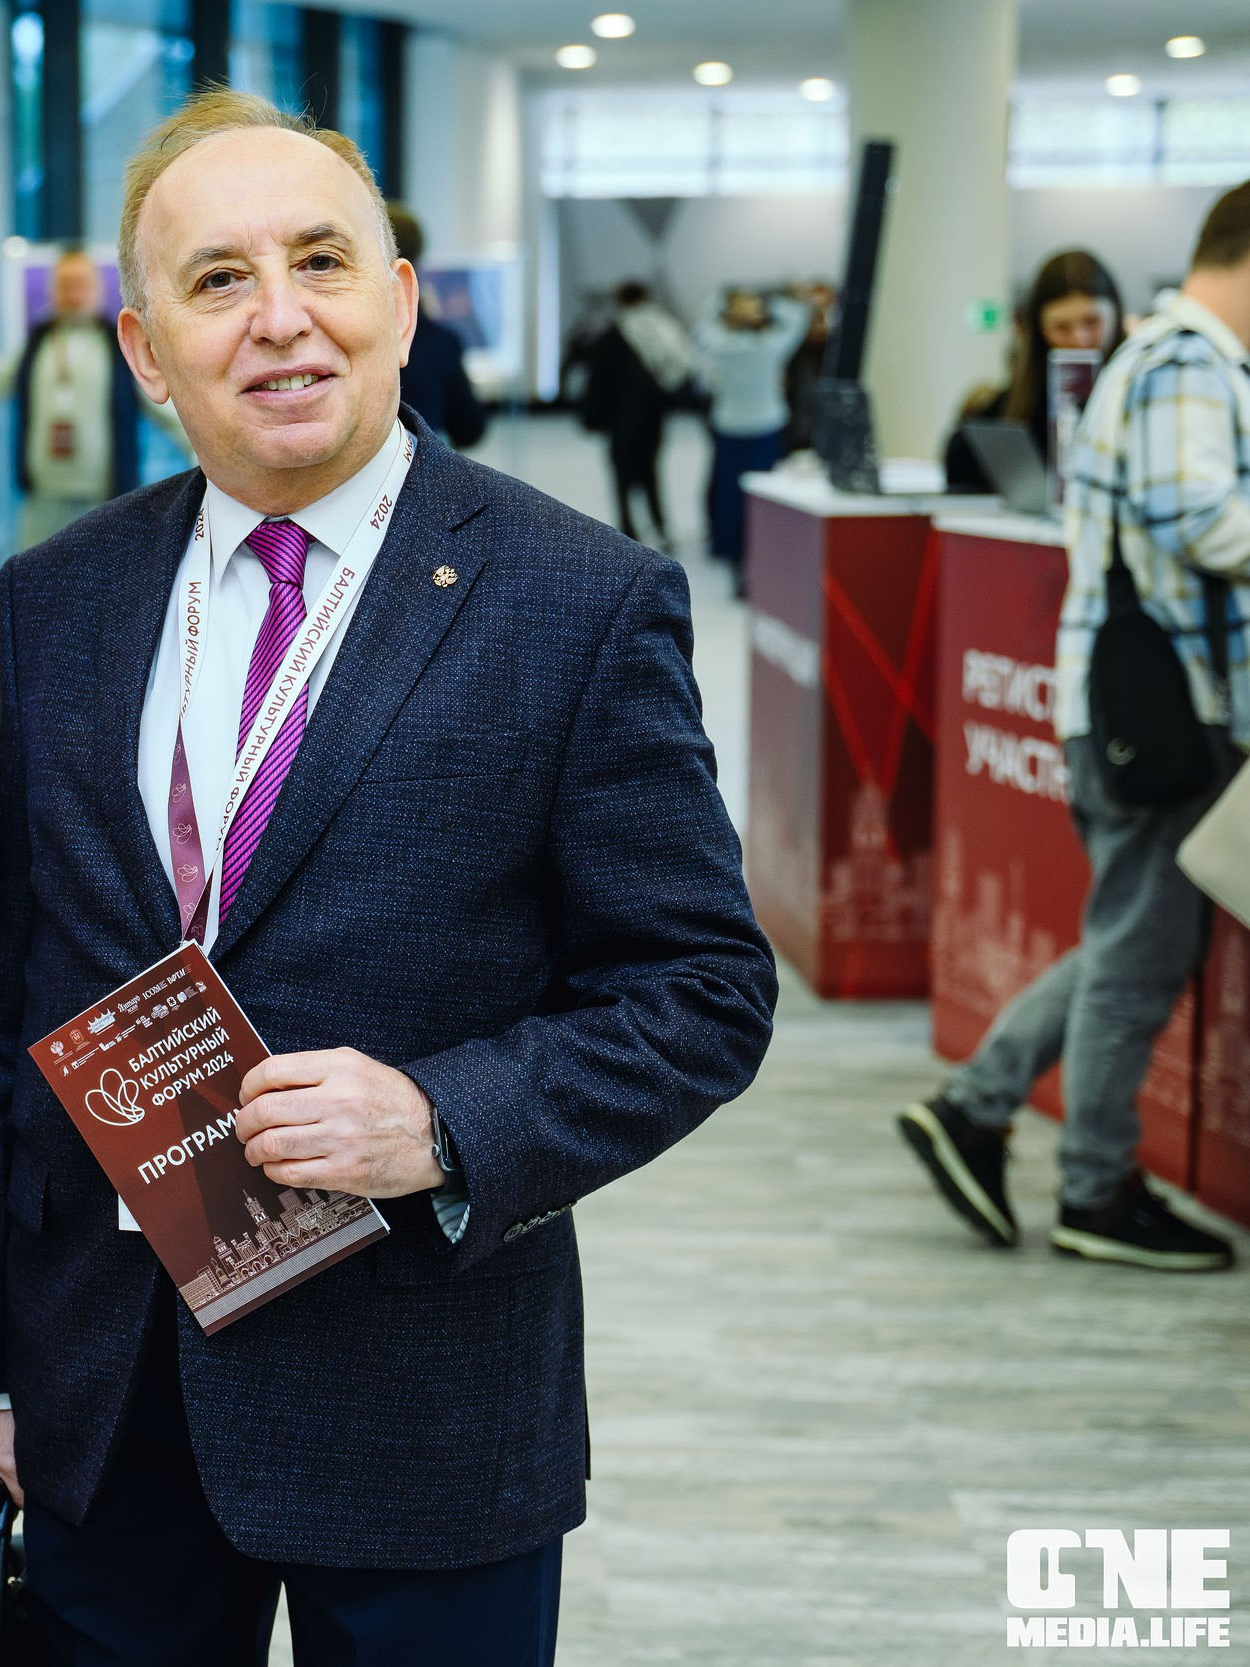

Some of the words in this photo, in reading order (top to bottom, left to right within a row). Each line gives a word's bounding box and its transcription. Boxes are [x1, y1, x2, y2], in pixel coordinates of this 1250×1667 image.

[370, 494, 393, 530] 2024
[187, 581, 202, 637] ФОРУМ
[291, 566, 356, 673] БАЛТИЙСКИЙ
[180, 639, 199, 718] ЬТУРНЫЙ
[235, 674, 297, 784] КУЛЬТУРНЫЙ
[128, 1006, 222, 1073] БАЛТИЙСКИЙ
[139, 1026, 230, 1090] КУЛЬТУРНЫЙ
[152, 1068, 205, 1107] ФОРУМ
[203, 1050, 234, 1077] 2024
[138, 1108, 240, 1184] ПРОГРАМ
